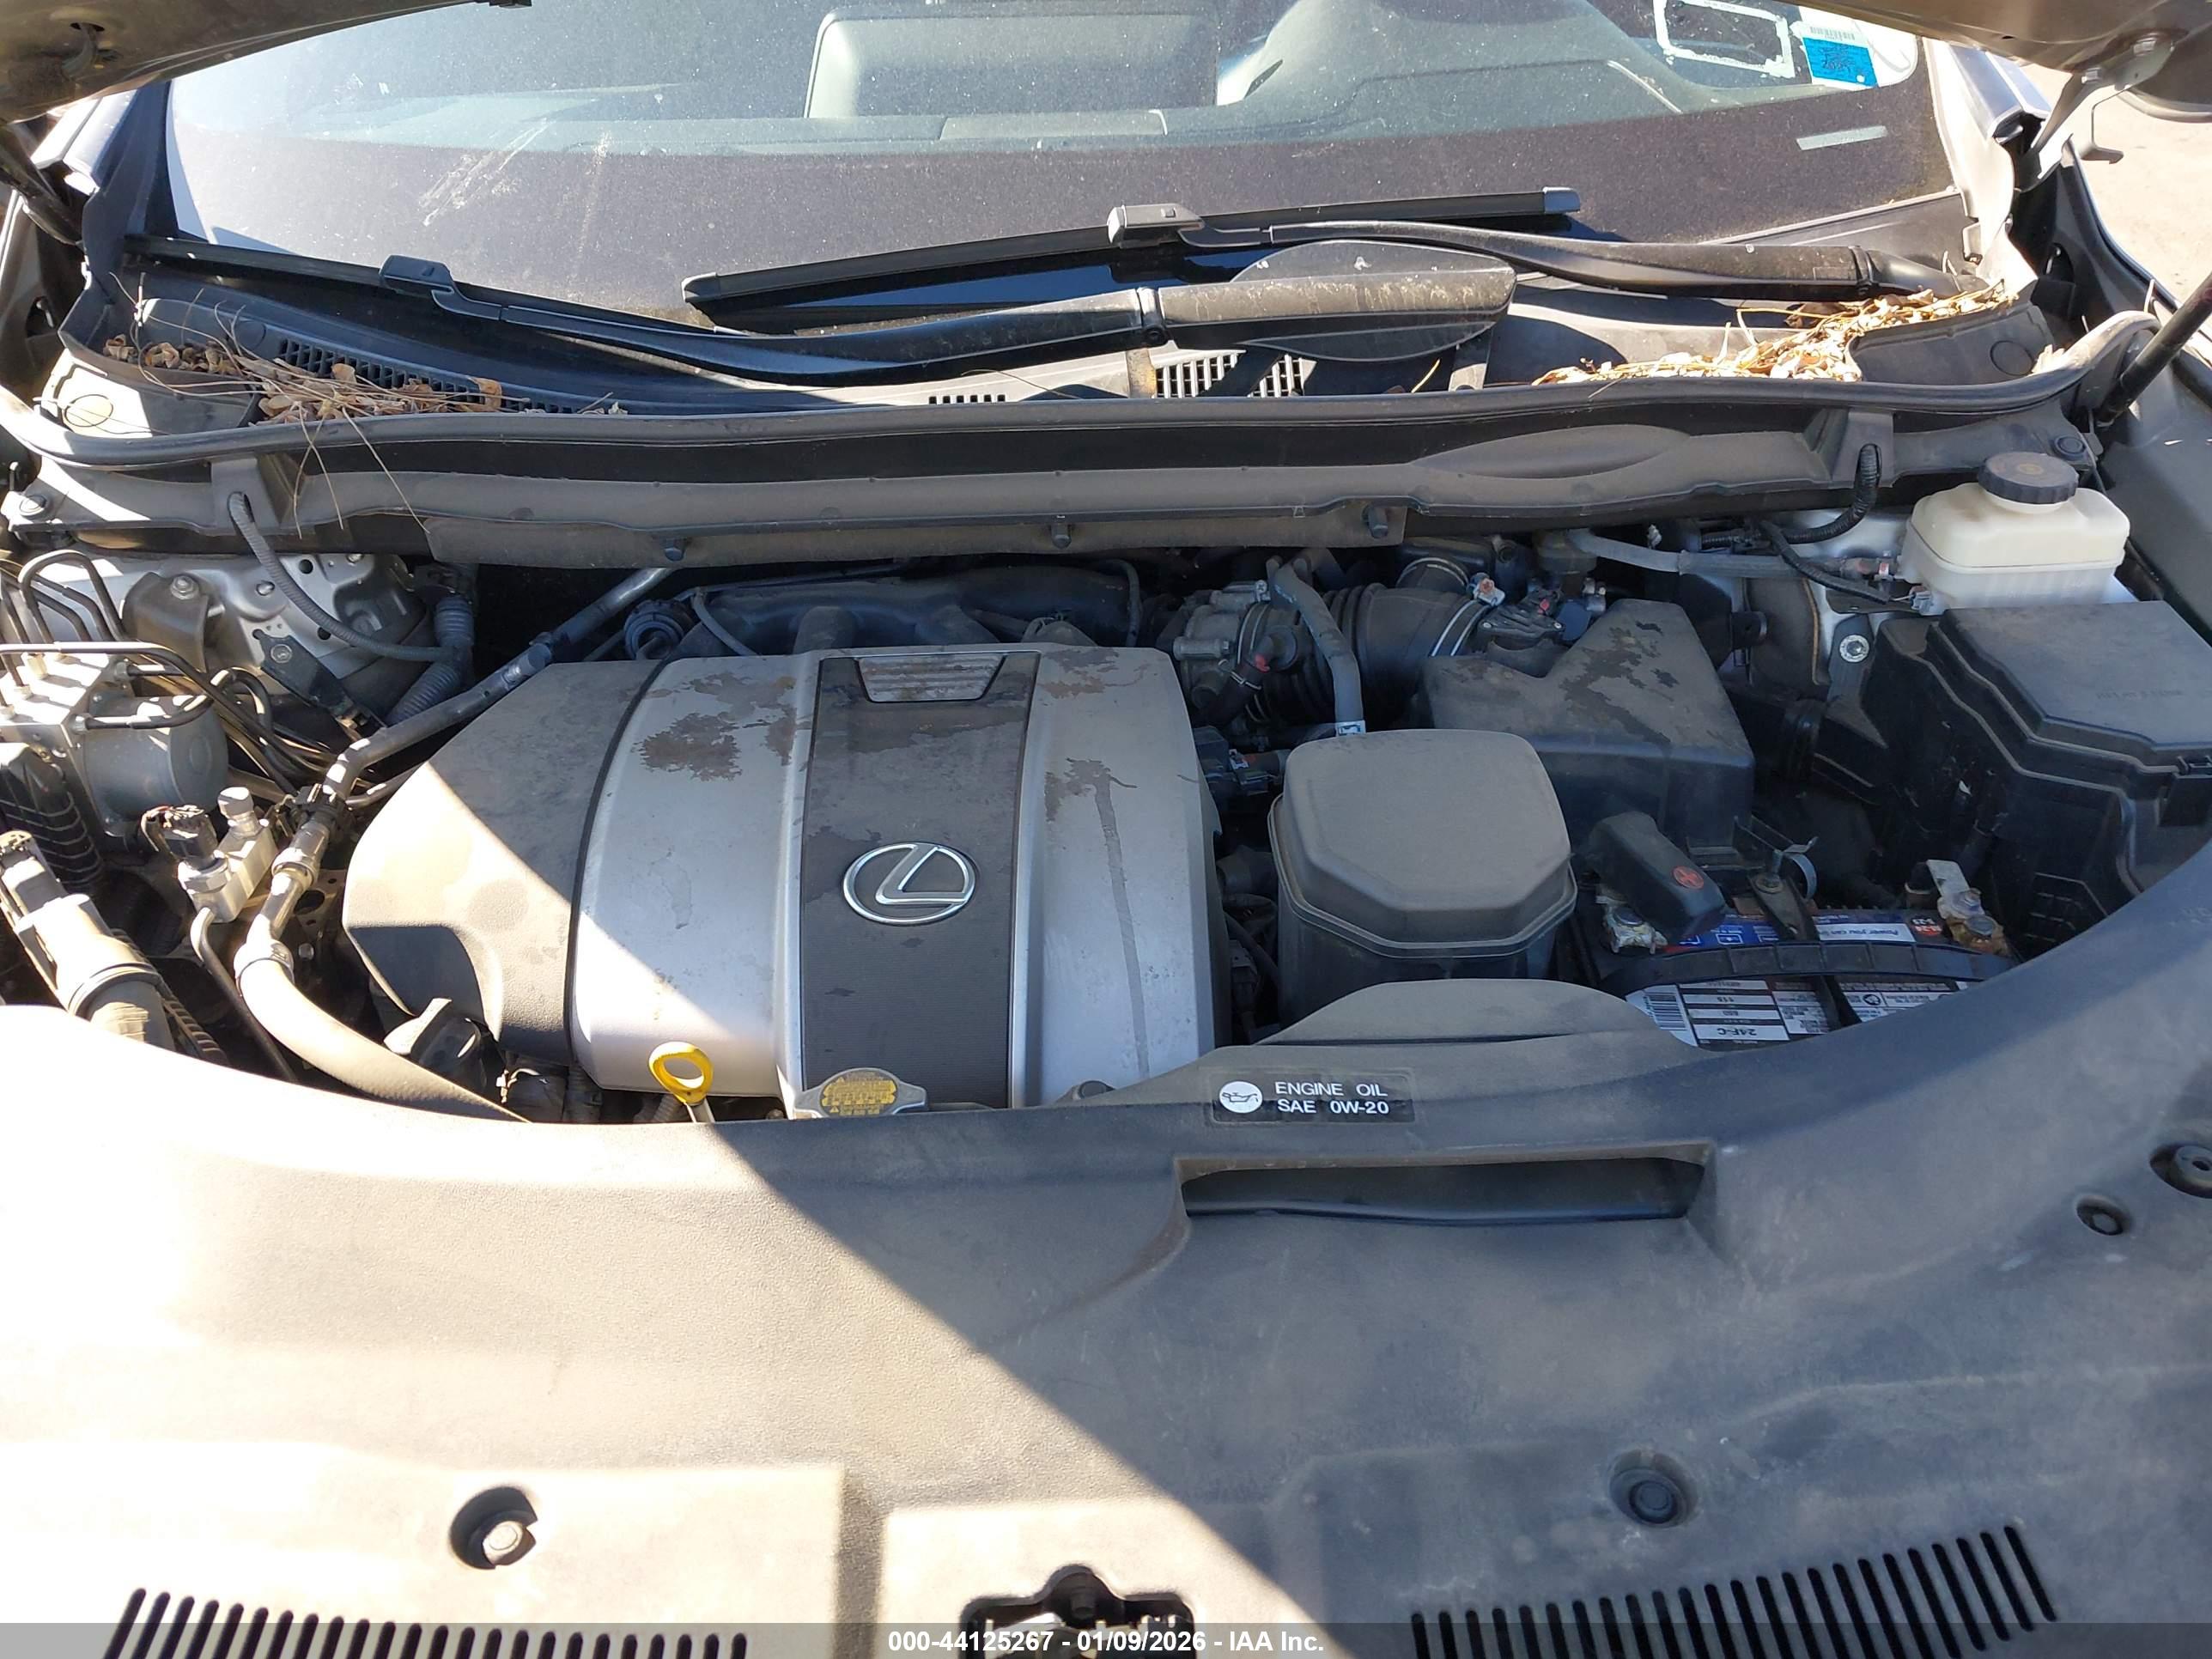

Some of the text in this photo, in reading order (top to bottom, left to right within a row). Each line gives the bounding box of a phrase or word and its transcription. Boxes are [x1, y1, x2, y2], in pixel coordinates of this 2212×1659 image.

[1717, 1027, 1757, 1036] 24F-C
[1275, 1081, 1389, 1097] ENGINE OIL
[1277, 1098, 1389, 1115] SAE 0W-20
